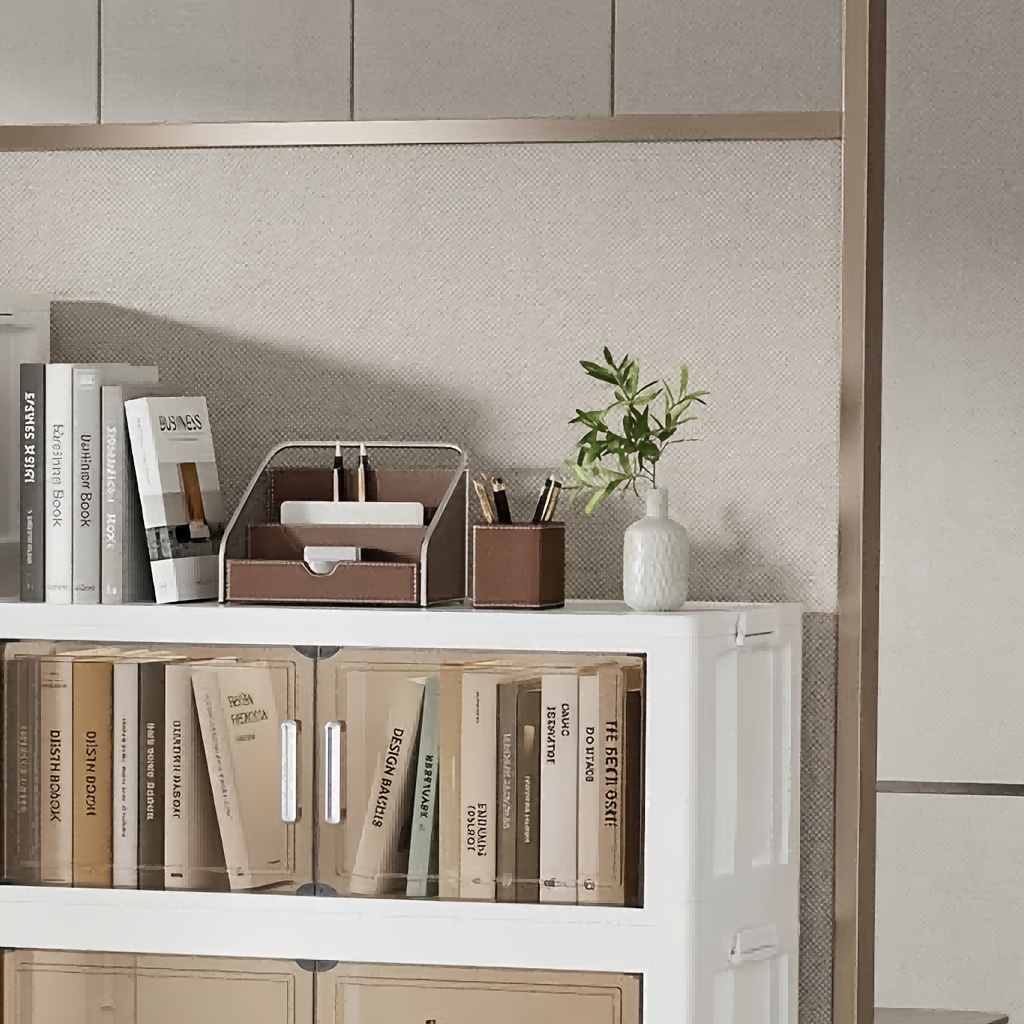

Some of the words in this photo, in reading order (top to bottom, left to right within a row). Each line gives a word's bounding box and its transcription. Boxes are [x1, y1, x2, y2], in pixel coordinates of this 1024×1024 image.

[52, 489, 64, 527] Book
[80, 493, 92, 527] Book
[381, 727, 404, 776] DESIGN
